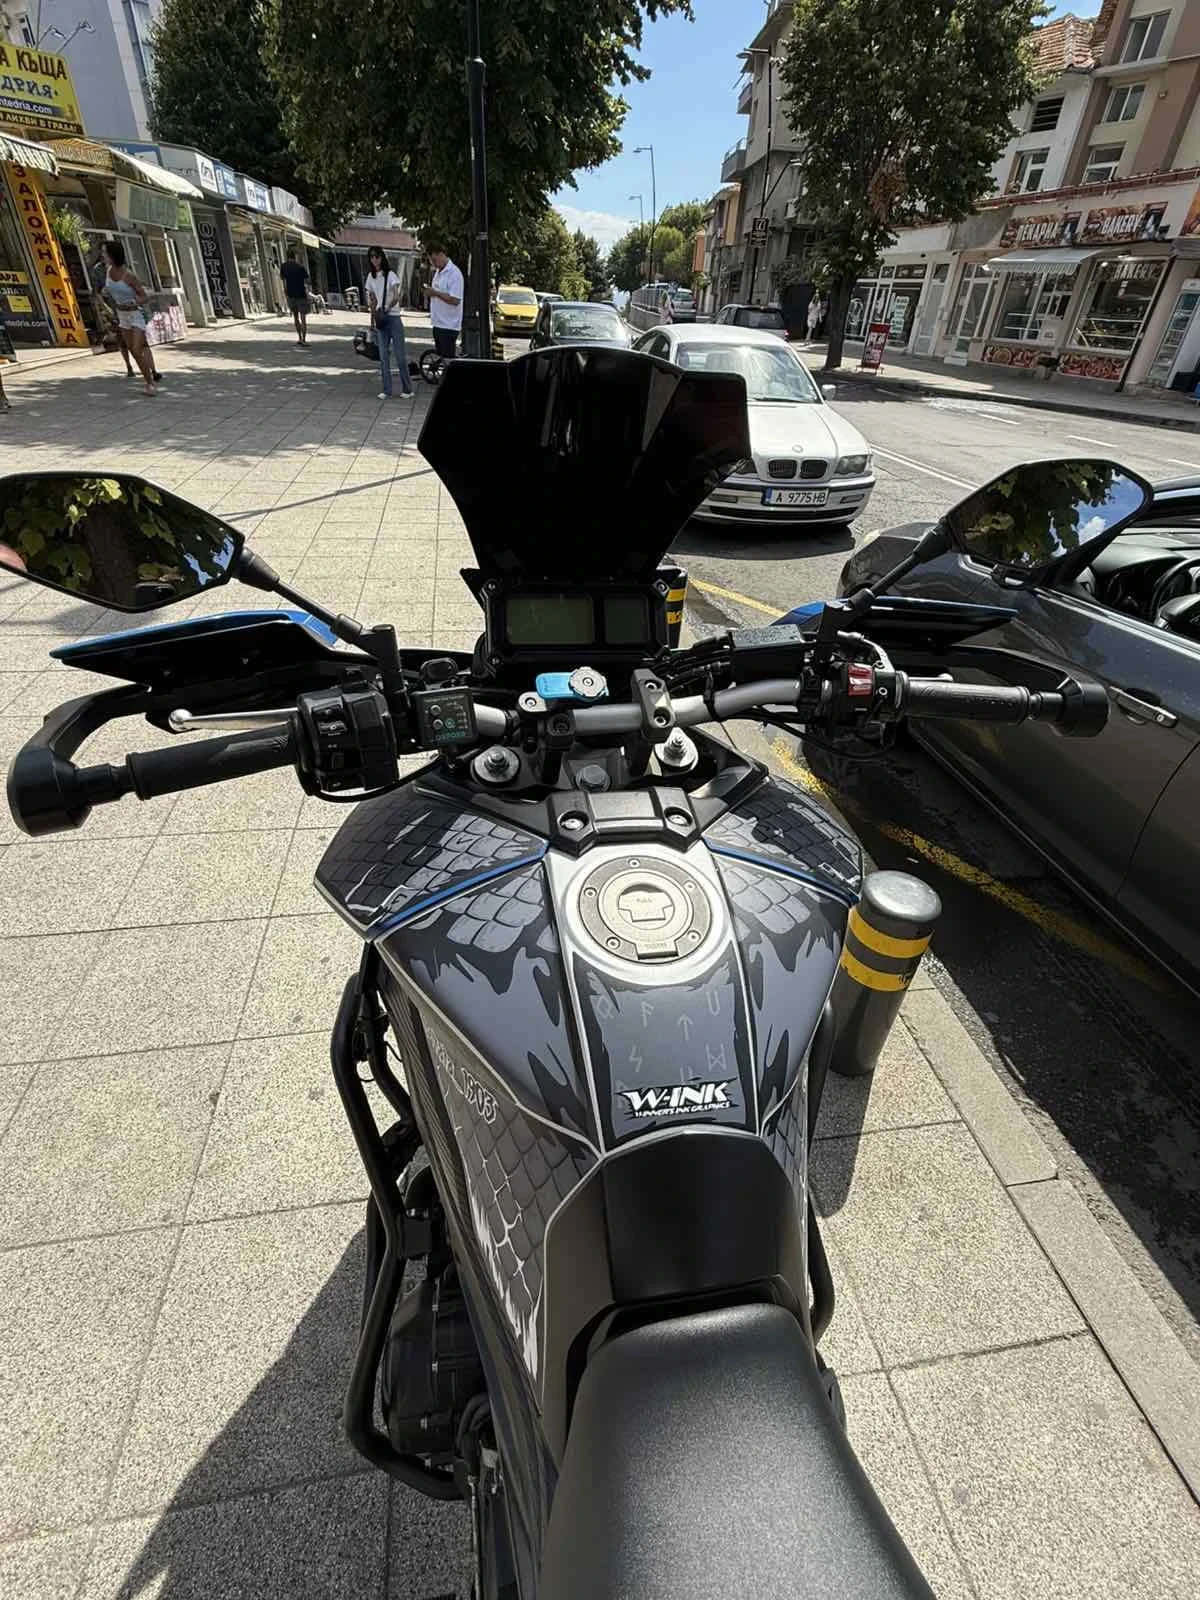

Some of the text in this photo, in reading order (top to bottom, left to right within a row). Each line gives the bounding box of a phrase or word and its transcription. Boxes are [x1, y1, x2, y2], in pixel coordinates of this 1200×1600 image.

[16, 49, 67, 80] КЪЩА
[1101, 214, 1143, 235] BAKERY
[12, 165, 78, 344] ЗАЛОЖНА КЪЩА
[621, 1082, 729, 1111] W-INK
